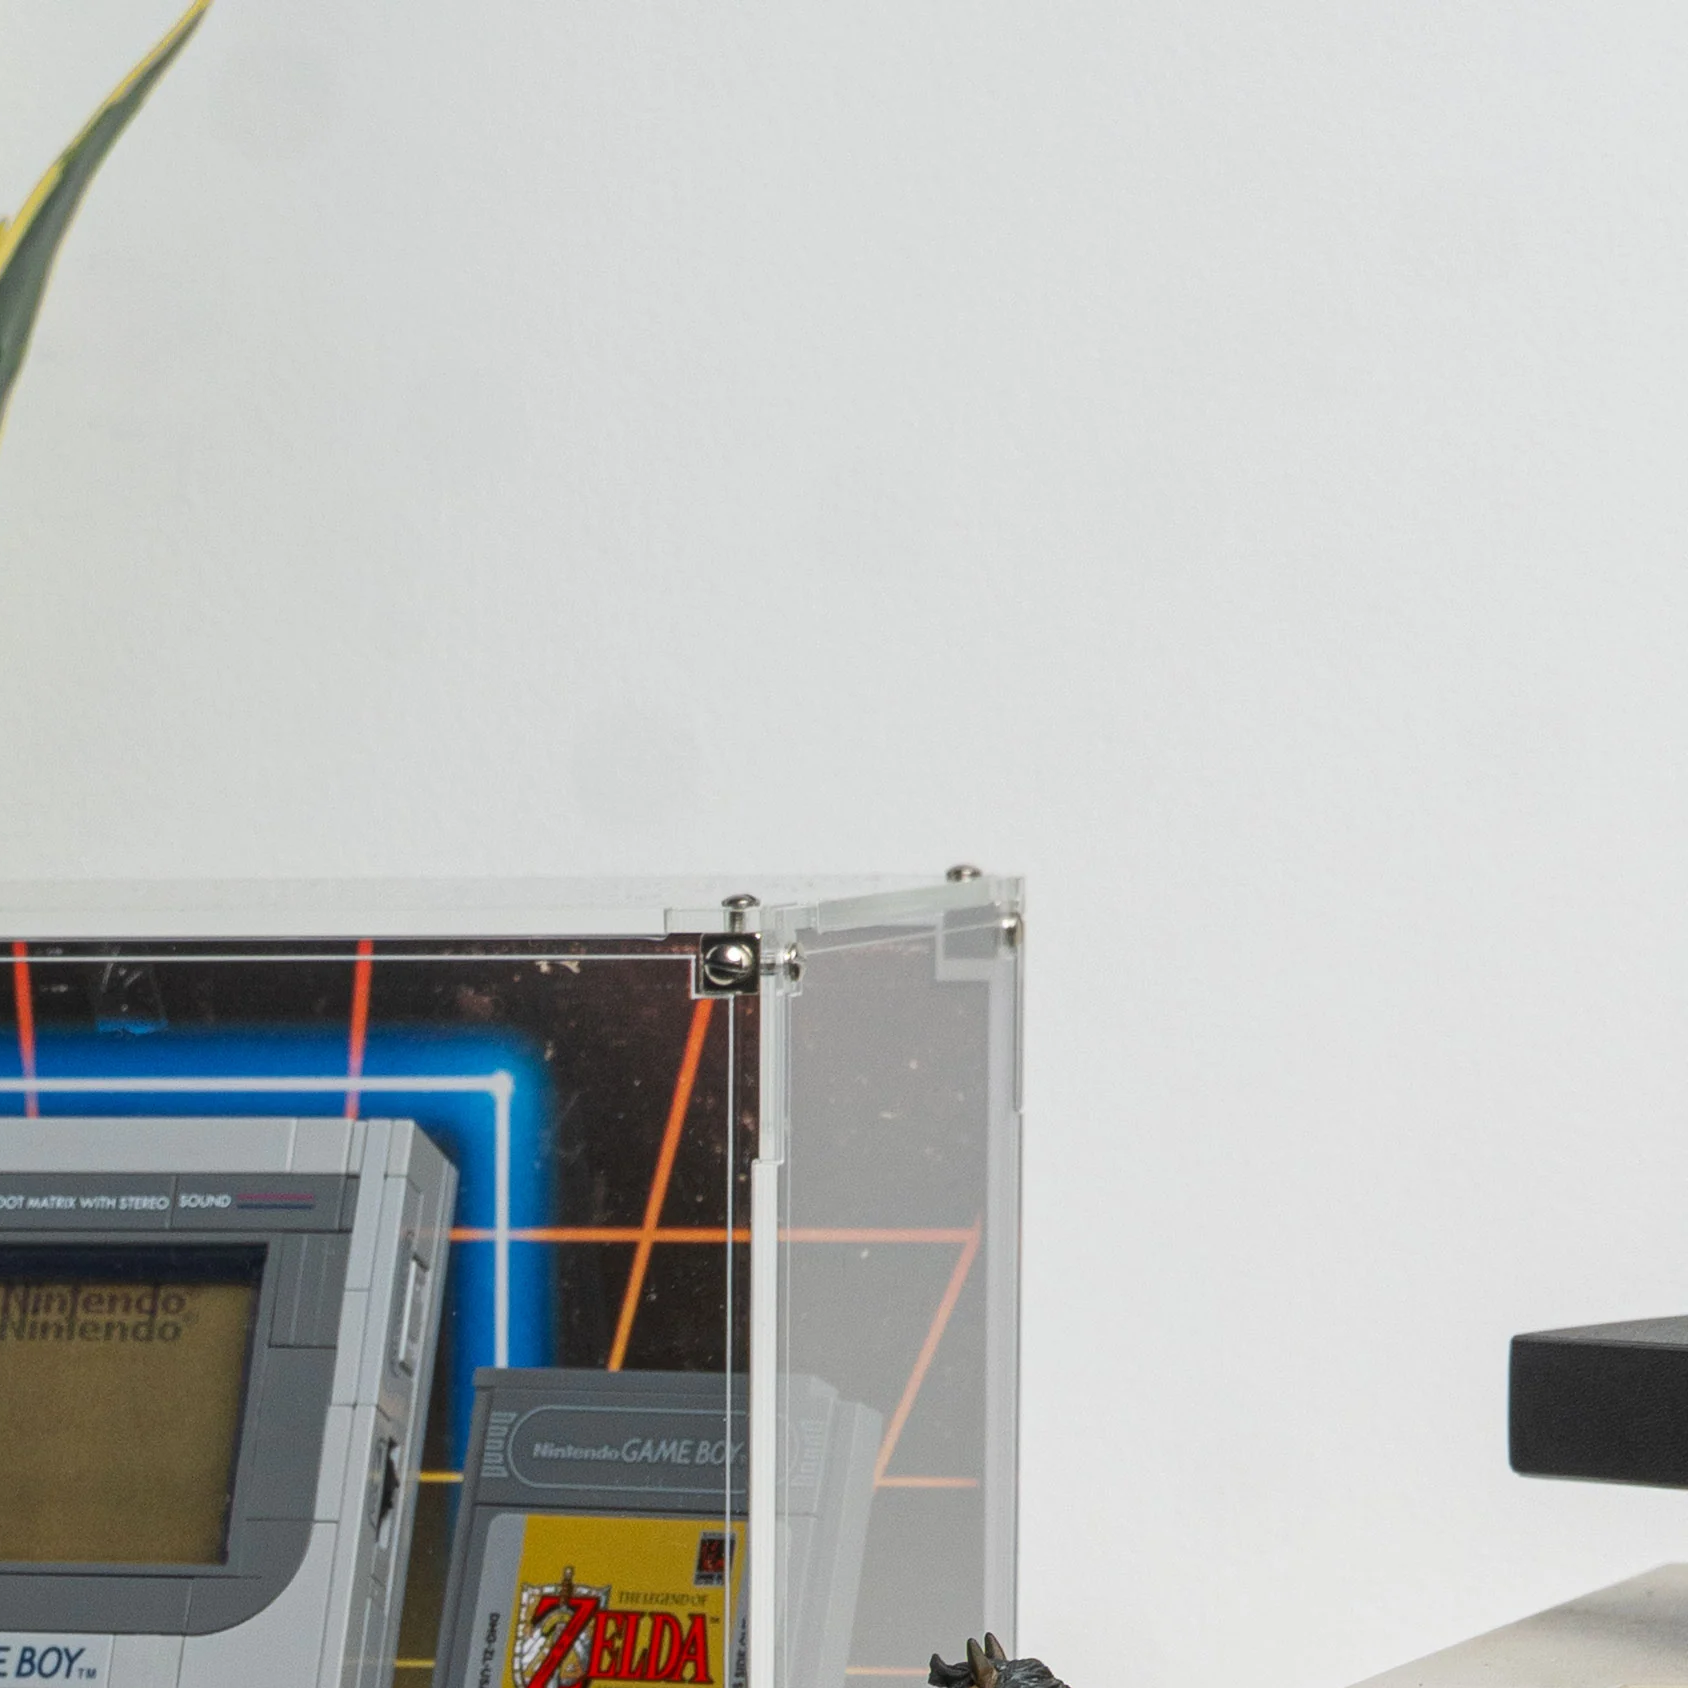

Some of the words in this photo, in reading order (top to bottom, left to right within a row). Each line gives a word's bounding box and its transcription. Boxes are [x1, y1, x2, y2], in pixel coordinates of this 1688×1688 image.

[26, 1195, 77, 1210] MATRIX
[80, 1195, 117, 1210] WITH
[118, 1195, 170, 1211] STEREO
[179, 1194, 232, 1208] SOUND
[532, 1442, 619, 1460] Nintendo
[620, 1438, 694, 1465] GAME
[695, 1440, 745, 1466] BOY
[14, 1646, 86, 1680] BOY
[734, 1652, 747, 1679] SIDE
